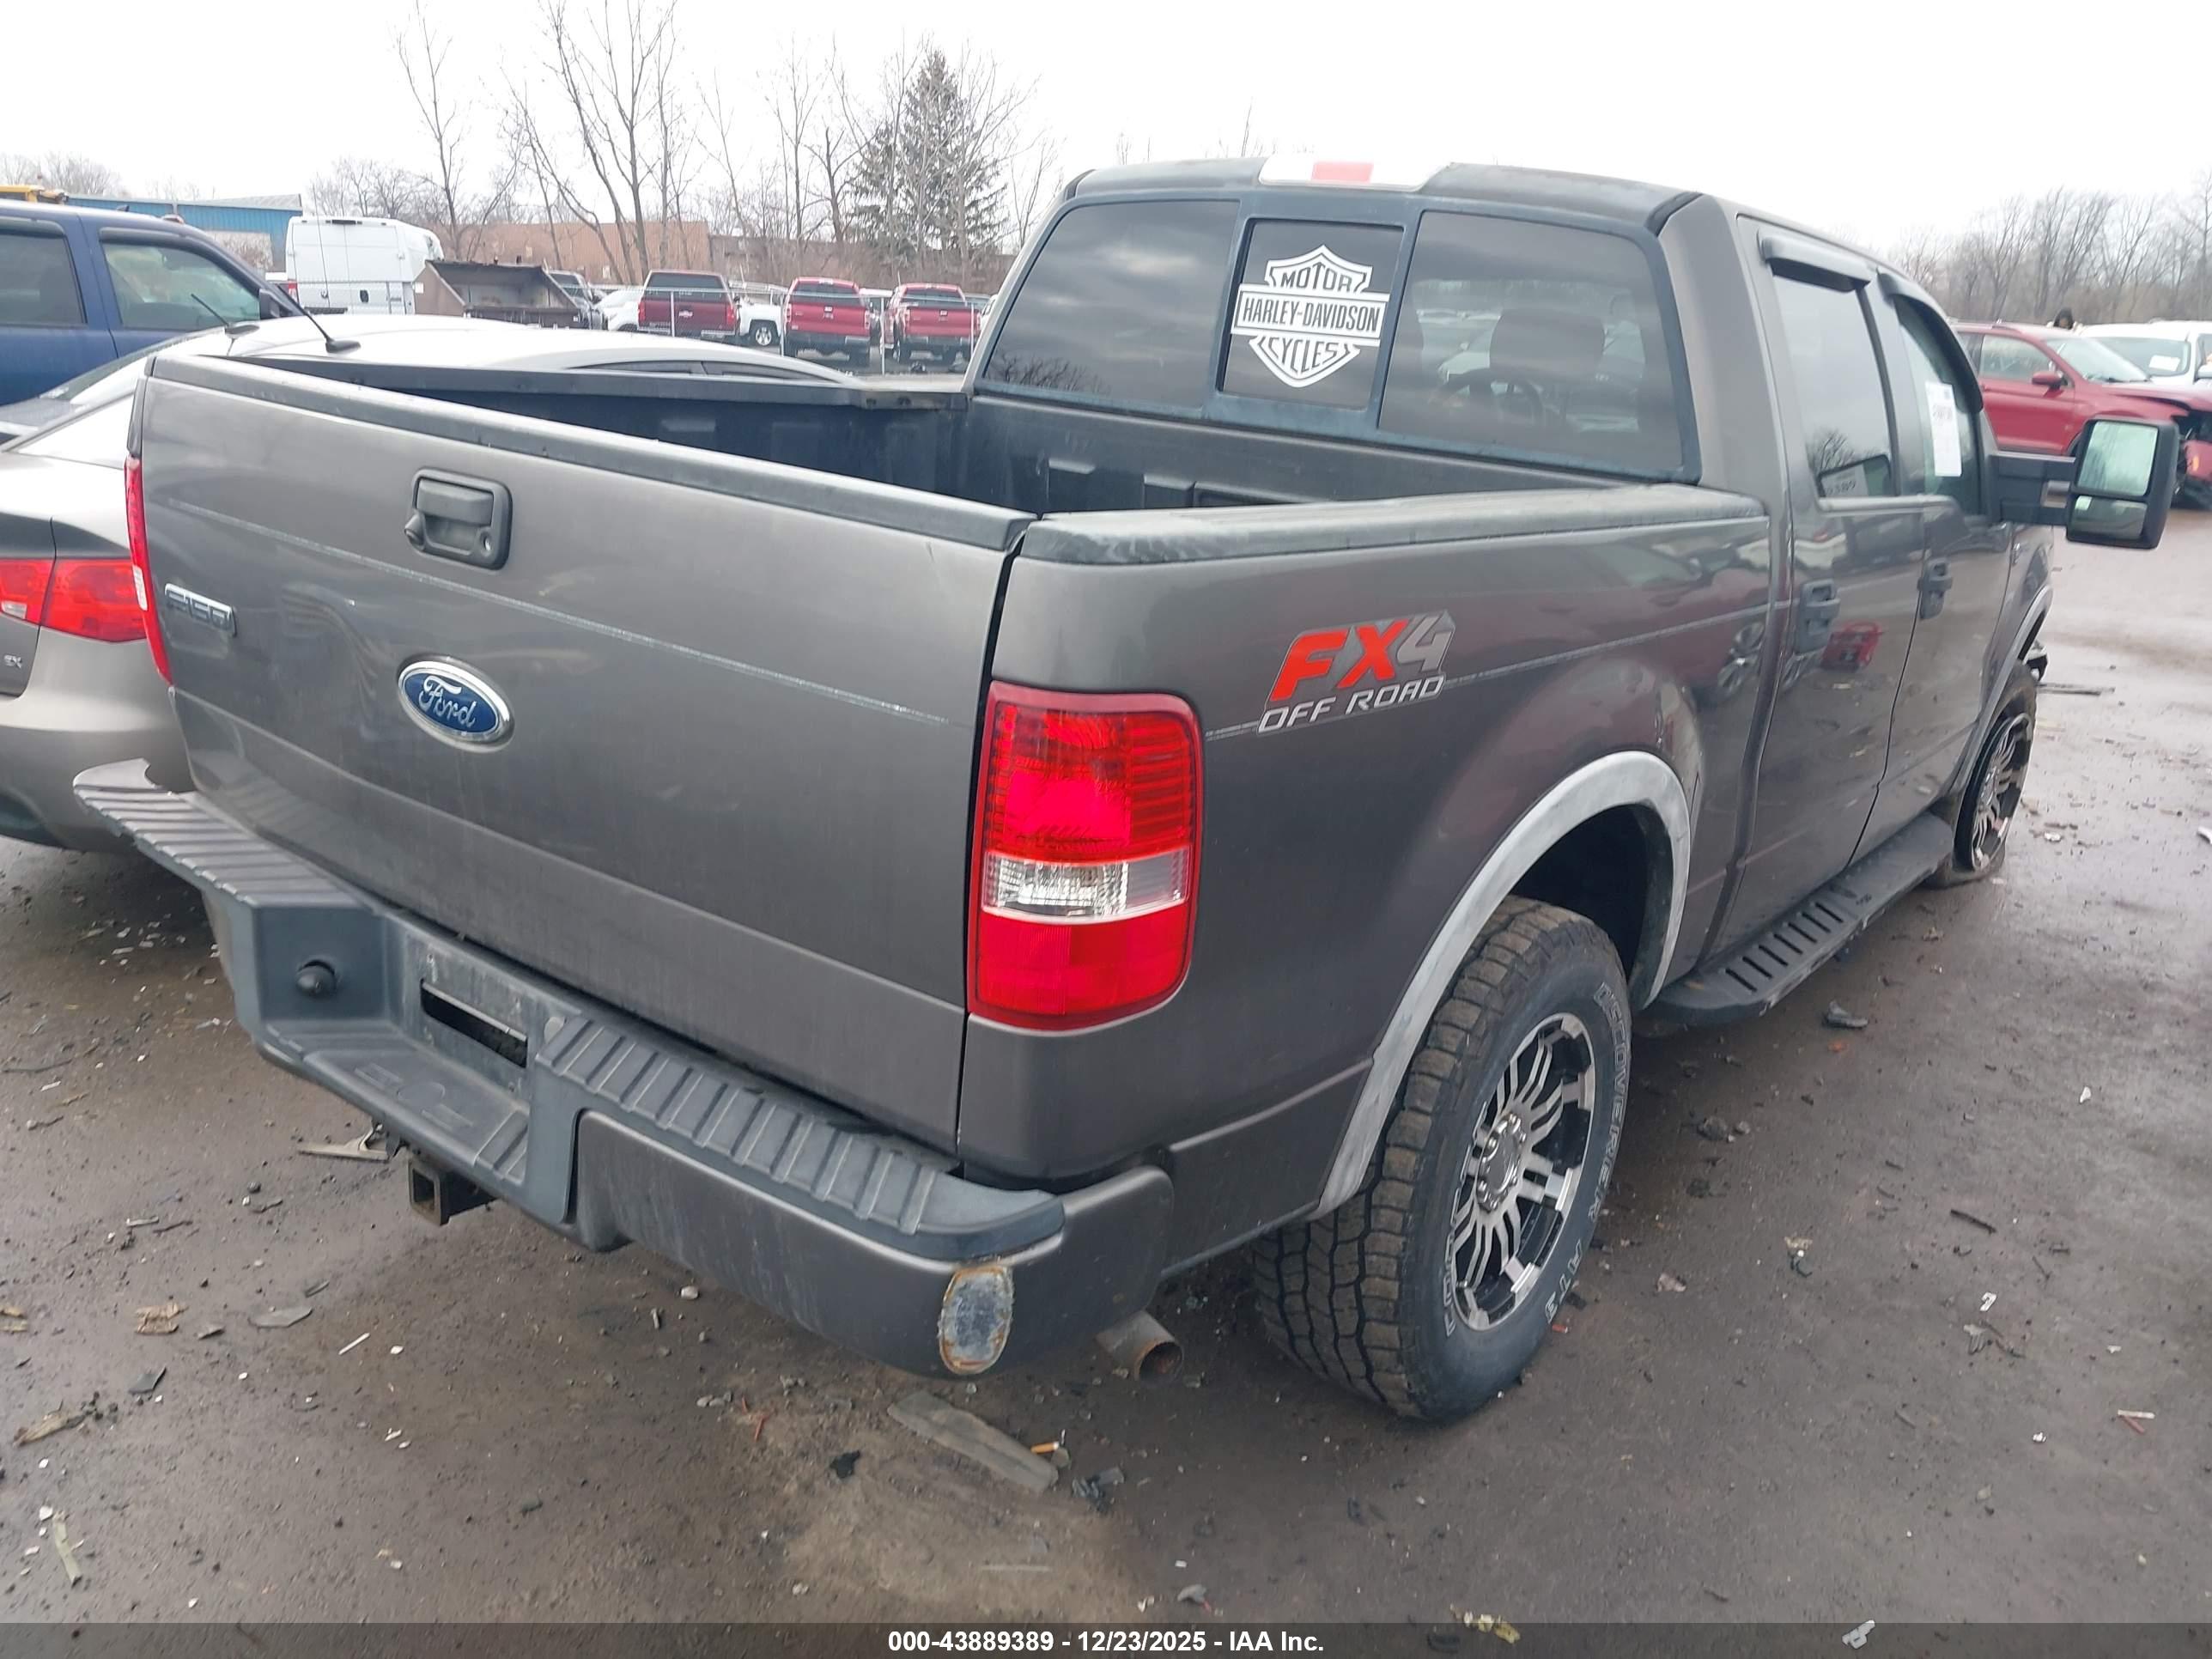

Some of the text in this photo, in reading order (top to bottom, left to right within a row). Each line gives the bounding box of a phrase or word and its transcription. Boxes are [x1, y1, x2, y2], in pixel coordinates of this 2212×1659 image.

[1280, 261, 1353, 293] MOTOR
[1243, 297, 1381, 332] HARLEY-DAVIDSON
[1268, 336, 1341, 374] CYCLES
[1270, 615, 1453, 702] FX4
[418, 675, 477, 727] Ford
[1257, 675, 1445, 733] OFF ROAD
[1589, 981, 1627, 1224] DISCOVERER
